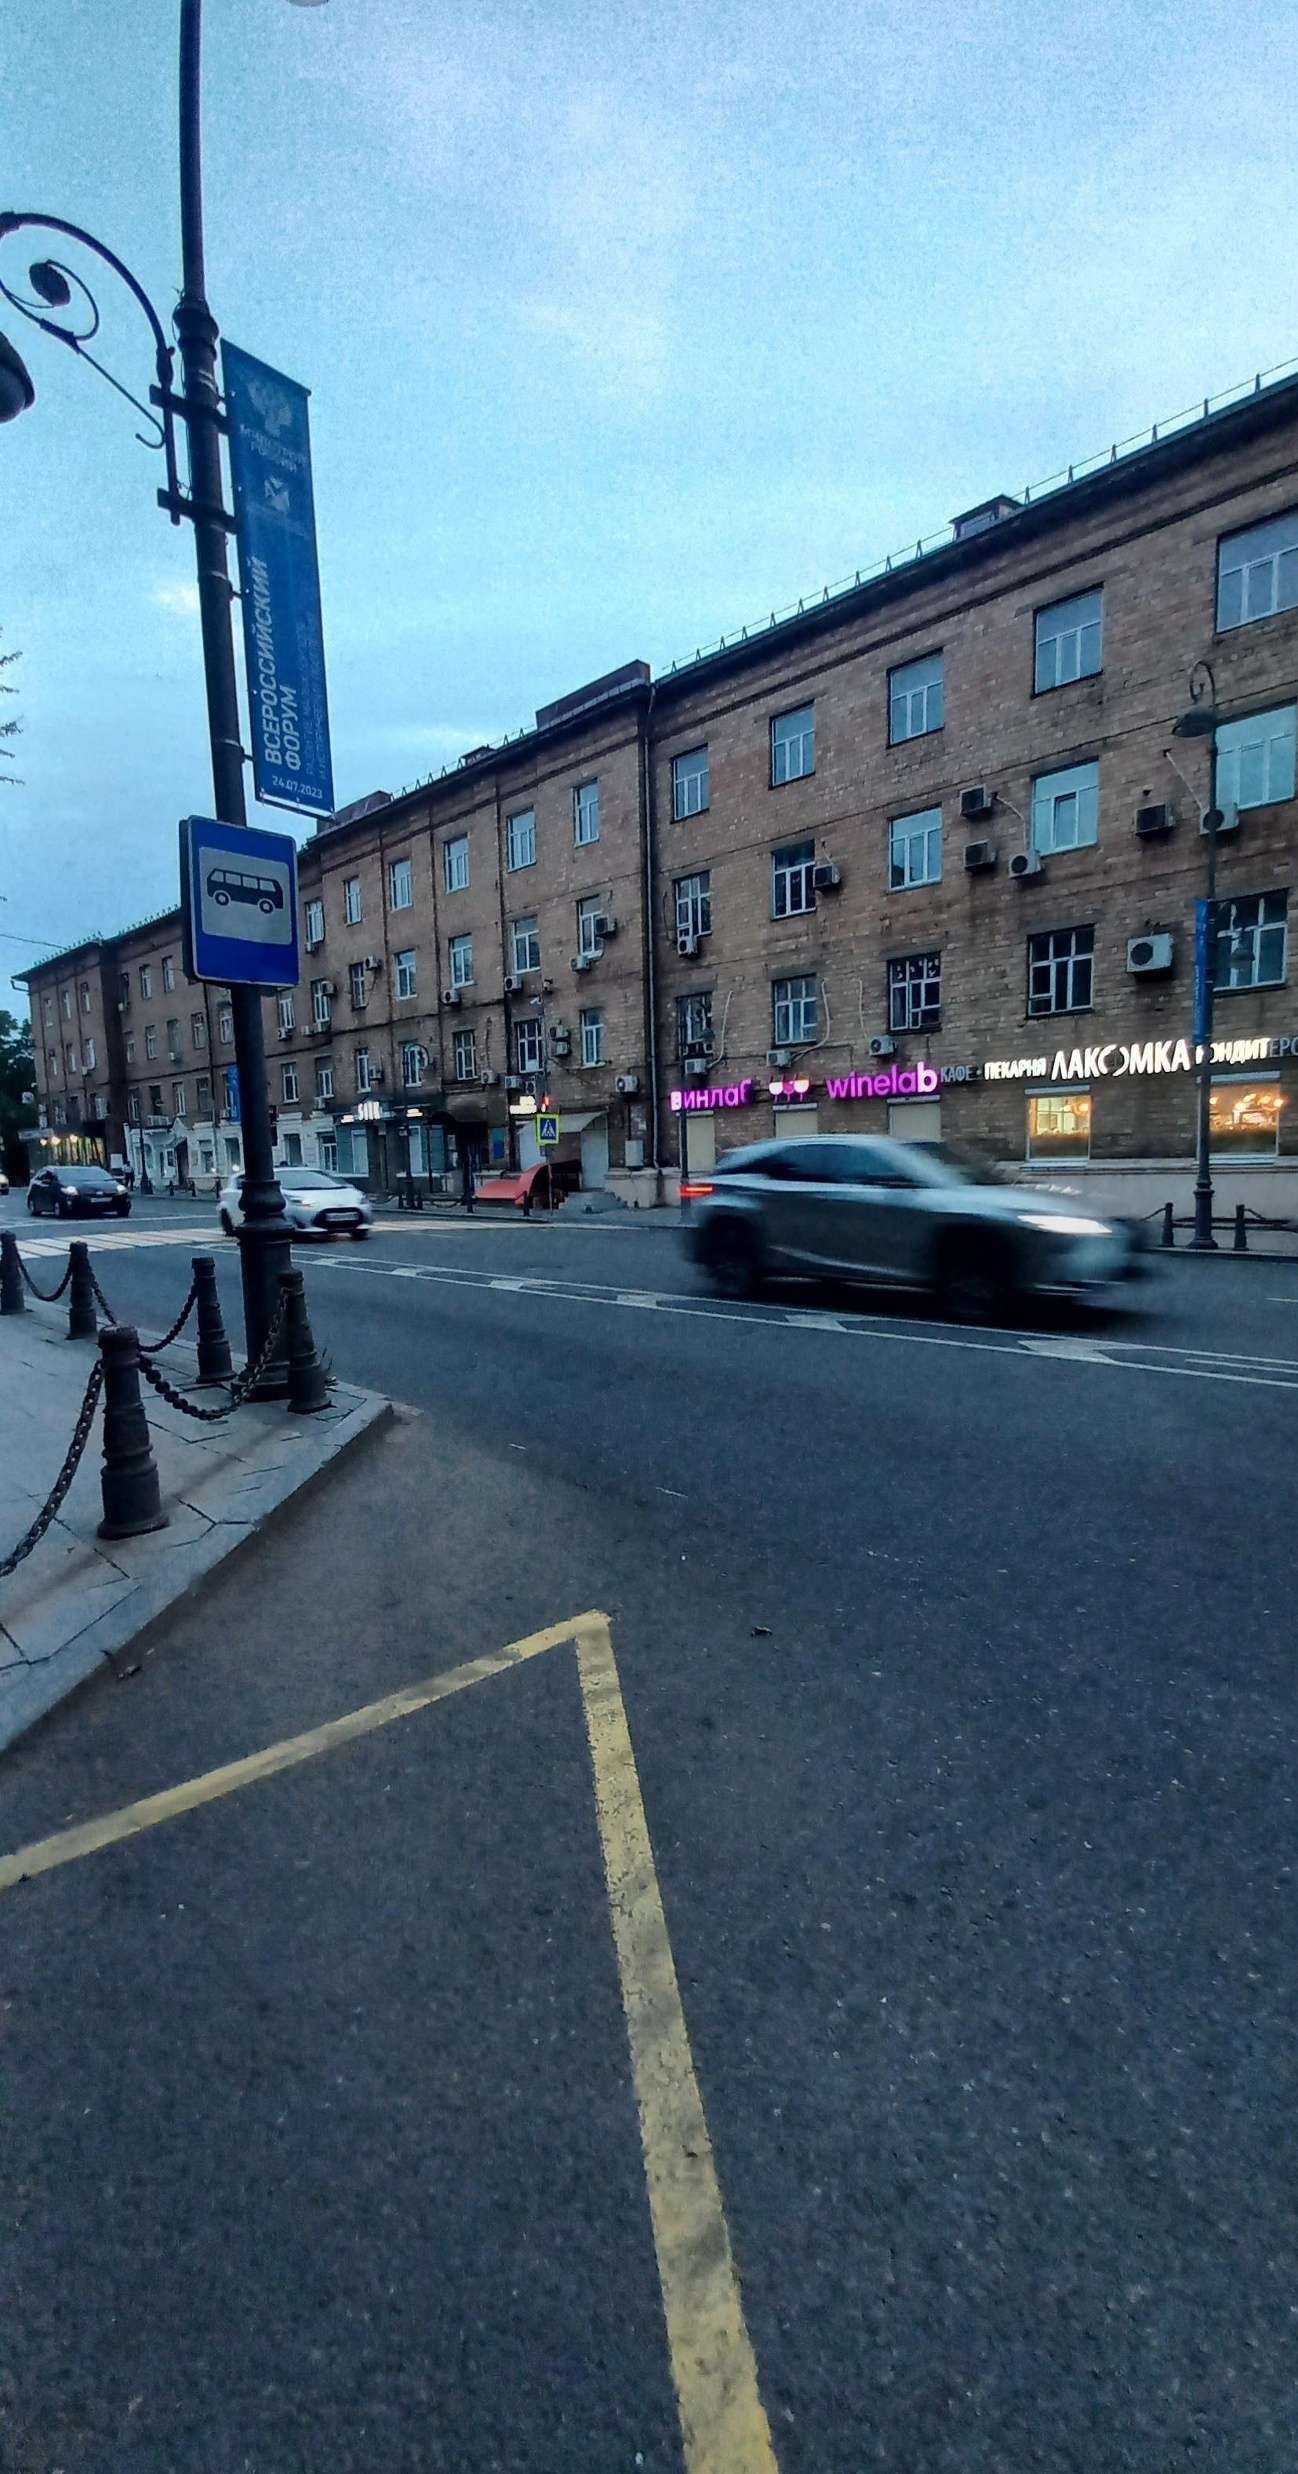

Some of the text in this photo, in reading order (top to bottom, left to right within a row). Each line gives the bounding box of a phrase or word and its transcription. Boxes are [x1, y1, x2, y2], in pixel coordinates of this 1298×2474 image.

[247, 556, 282, 766] ВСЕРОССИЙСКИЙ
[279, 685, 301, 771] ФОРУМ
[272, 775, 323, 799] 24.07.2023
[826, 1061, 938, 1099] winelab
[941, 1065, 975, 1082] КАФЕ
[1051, 1039, 1191, 1080] ЛАКОМКА
